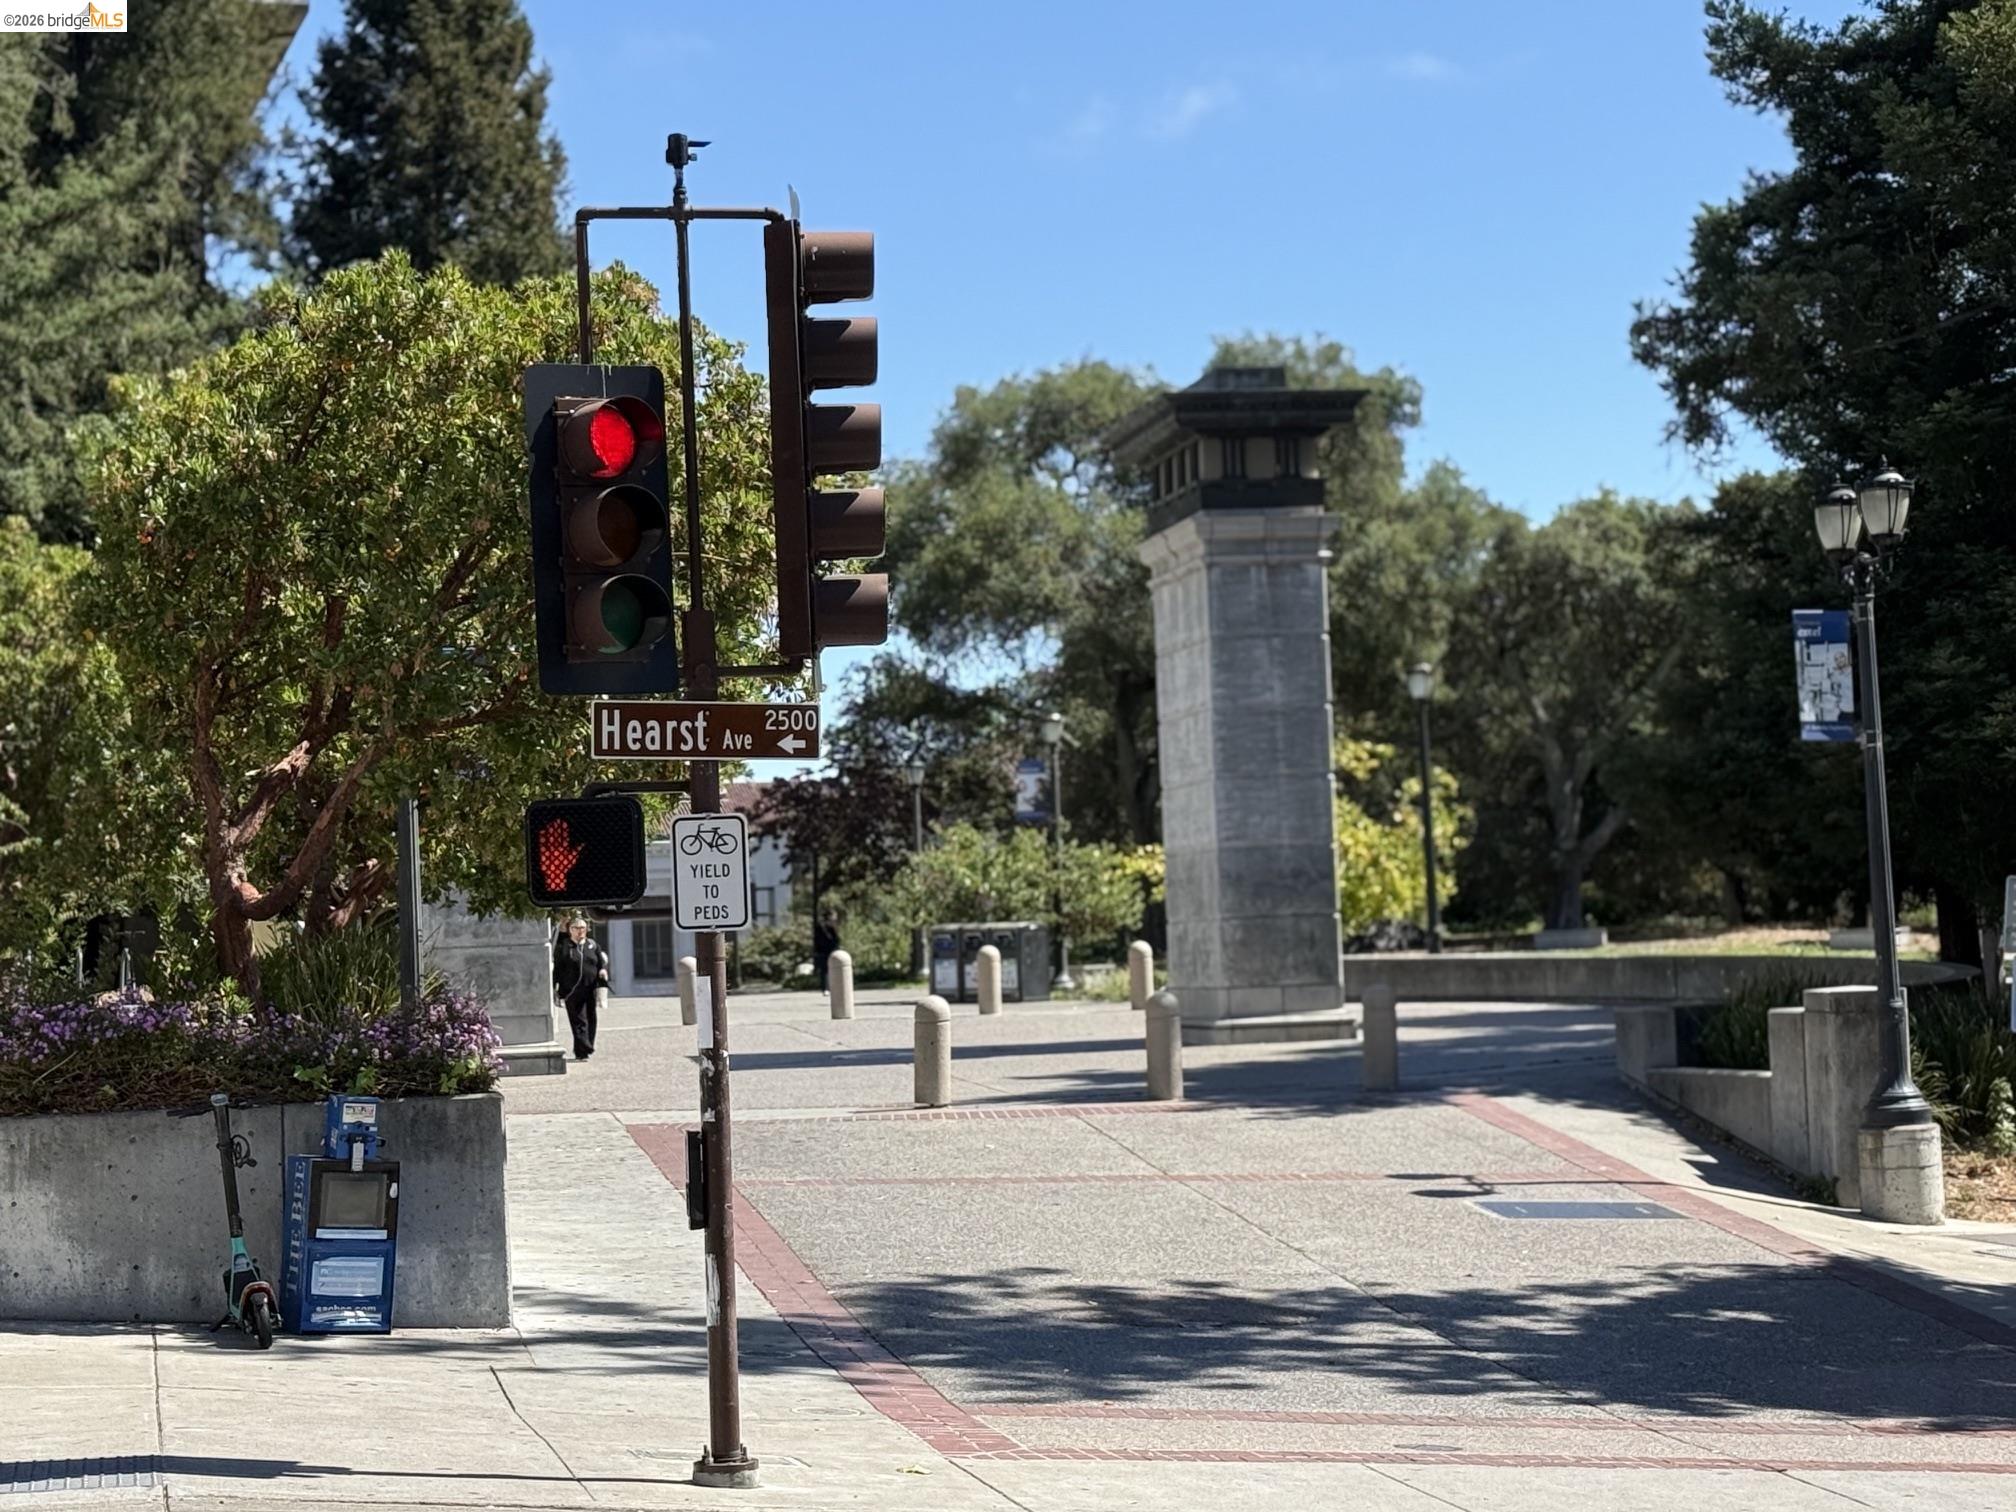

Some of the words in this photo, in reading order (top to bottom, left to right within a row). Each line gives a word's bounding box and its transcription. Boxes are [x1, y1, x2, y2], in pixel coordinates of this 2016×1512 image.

[601, 709, 708, 751] Hearst
[722, 728, 753, 750] Ave
[764, 709, 817, 731] 2500
[690, 863, 730, 879] YIELD
[702, 884, 719, 899] TO
[694, 905, 729, 920] PEDS
[291, 1161, 306, 1221] BEE
[286, 1228, 301, 1298] THE
